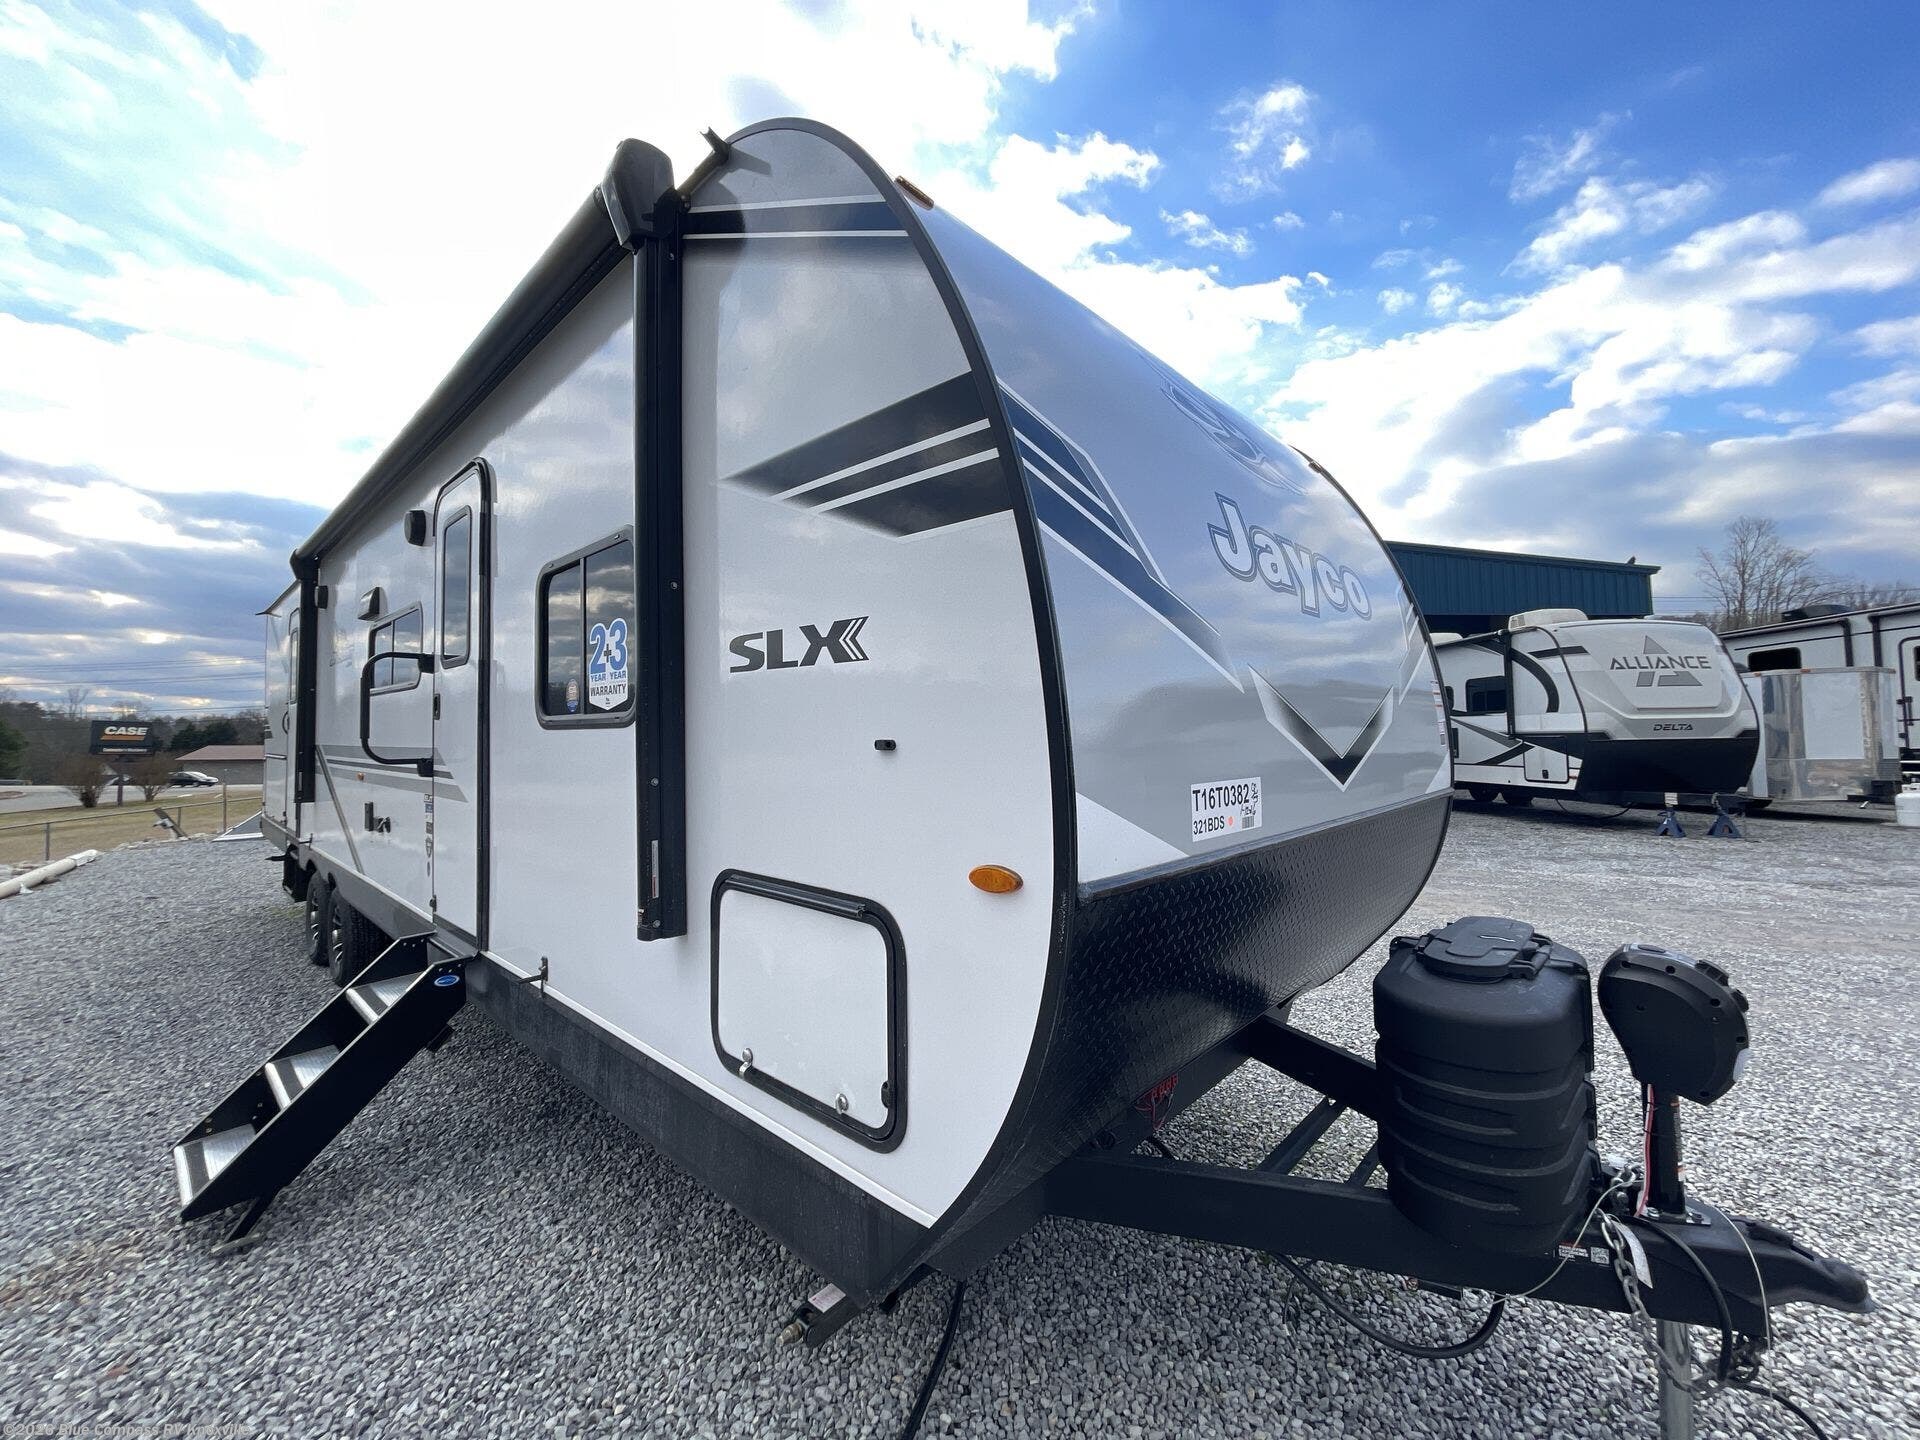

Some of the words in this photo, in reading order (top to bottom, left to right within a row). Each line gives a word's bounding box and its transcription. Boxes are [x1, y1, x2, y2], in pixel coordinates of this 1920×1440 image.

[1206, 491, 1372, 621] Jayco
[729, 615, 869, 674] SLX
[1610, 655, 1712, 670] ALLIANCE
[590, 673, 607, 683] YEAR
[609, 670, 627, 680] YEAR
[590, 683, 627, 697] WARRANTY
[104, 725, 149, 736] CASE
[1653, 723, 1693, 732] DELTA
[1192, 783, 1250, 812] T16T0382
[1193, 815, 1225, 835] 321BDS
